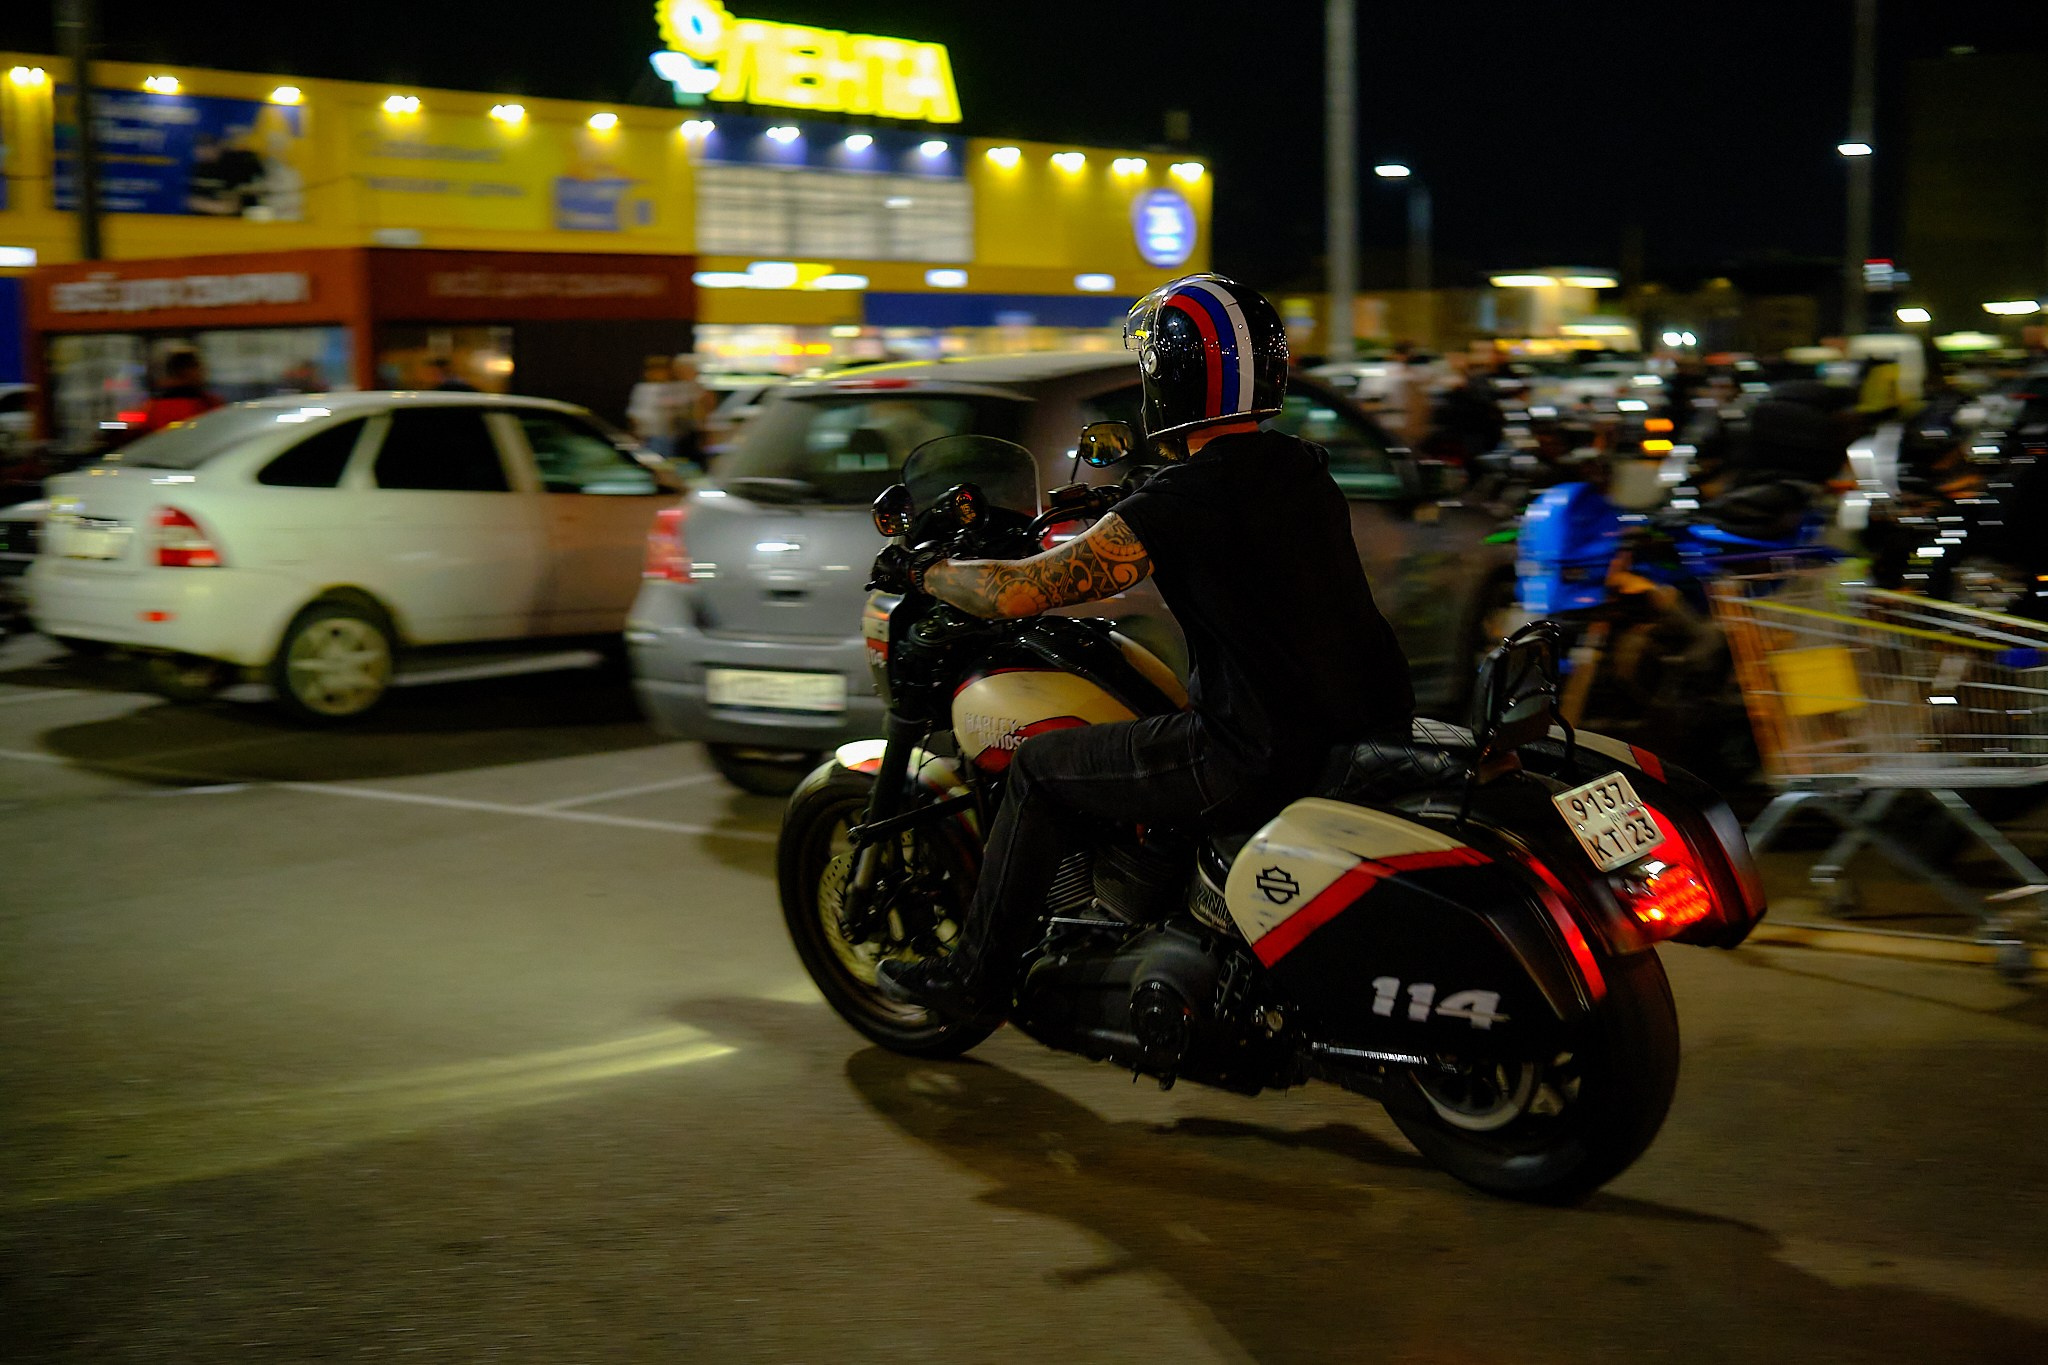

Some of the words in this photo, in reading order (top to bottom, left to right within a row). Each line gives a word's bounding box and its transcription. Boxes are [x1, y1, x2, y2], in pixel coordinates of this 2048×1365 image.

[708, 17, 962, 123] ЛЕНТА
[1572, 781, 1626, 820] 9137
[1625, 816, 1656, 846] 23
[1372, 976, 1511, 1030] 114
